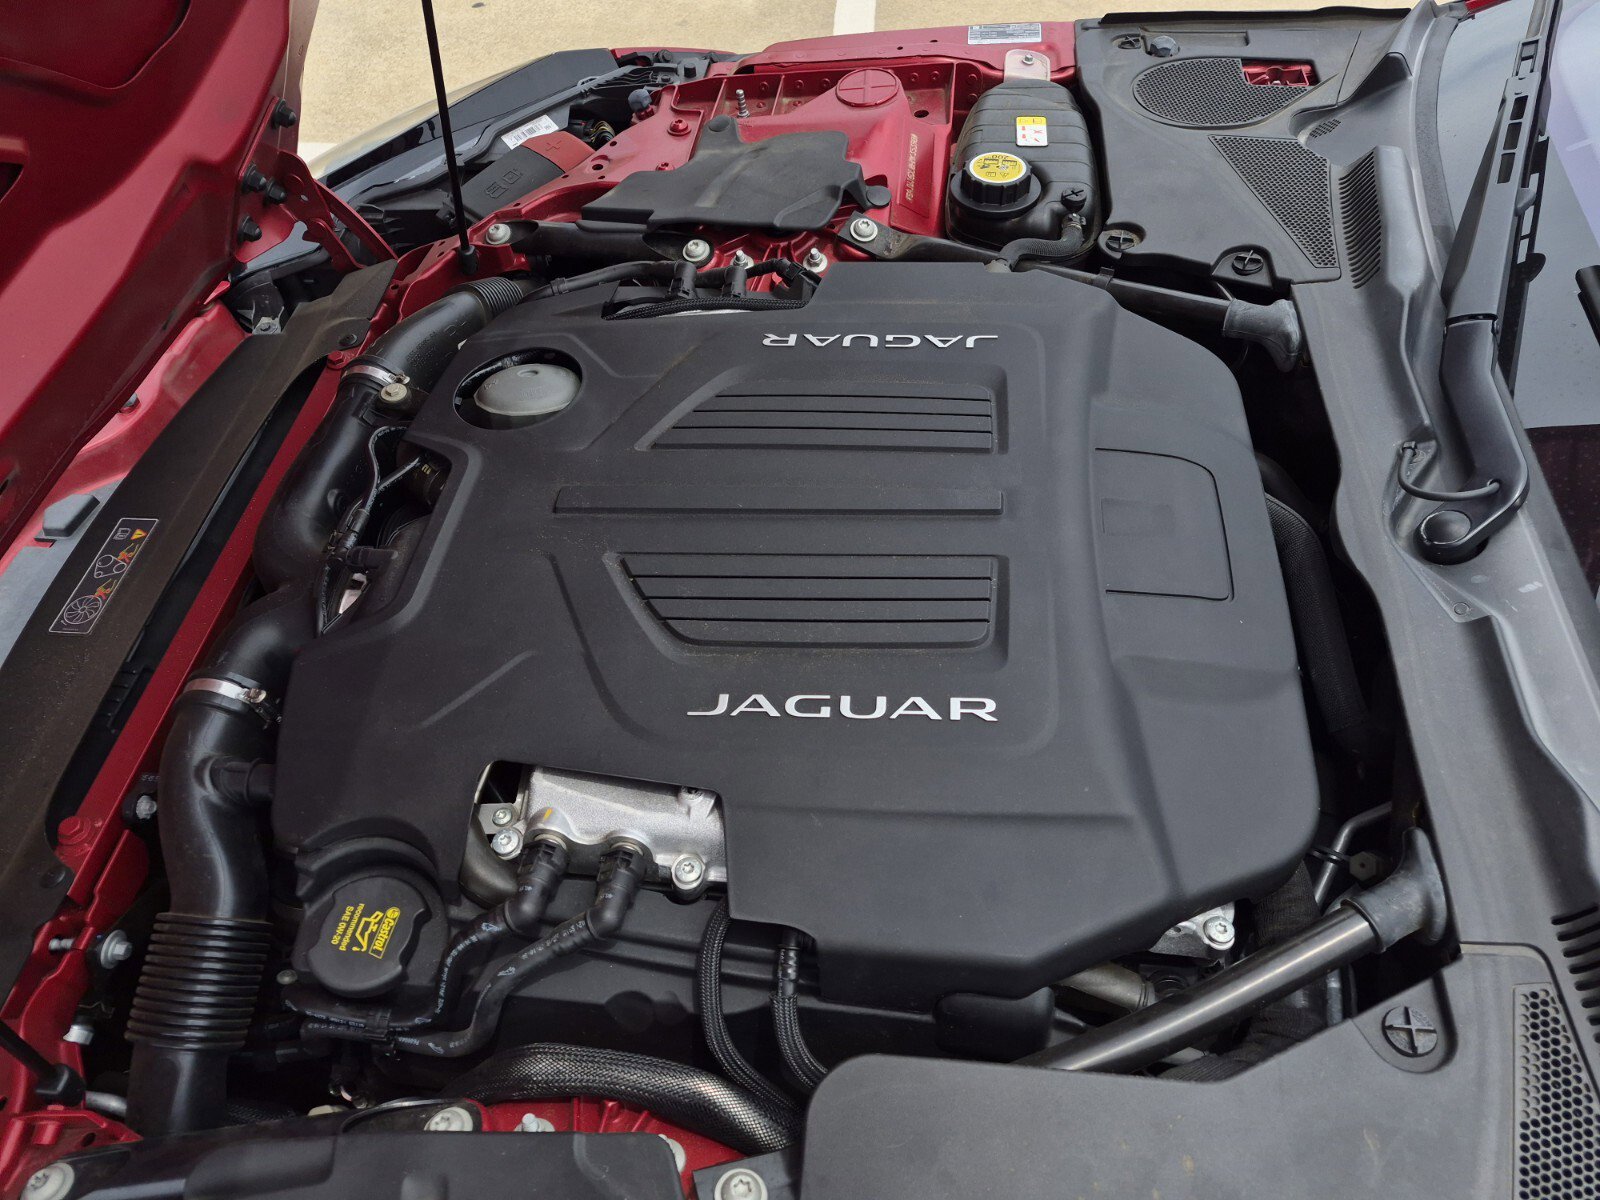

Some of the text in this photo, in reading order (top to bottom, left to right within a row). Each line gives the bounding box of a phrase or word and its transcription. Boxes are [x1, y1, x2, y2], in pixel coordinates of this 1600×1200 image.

[762, 333, 999, 348] JAGUAR
[687, 693, 999, 722] JAGUAR
[331, 906, 355, 945] SAE 0W-20
[339, 903, 365, 952] recommended
[373, 918, 395, 952] Castrol
